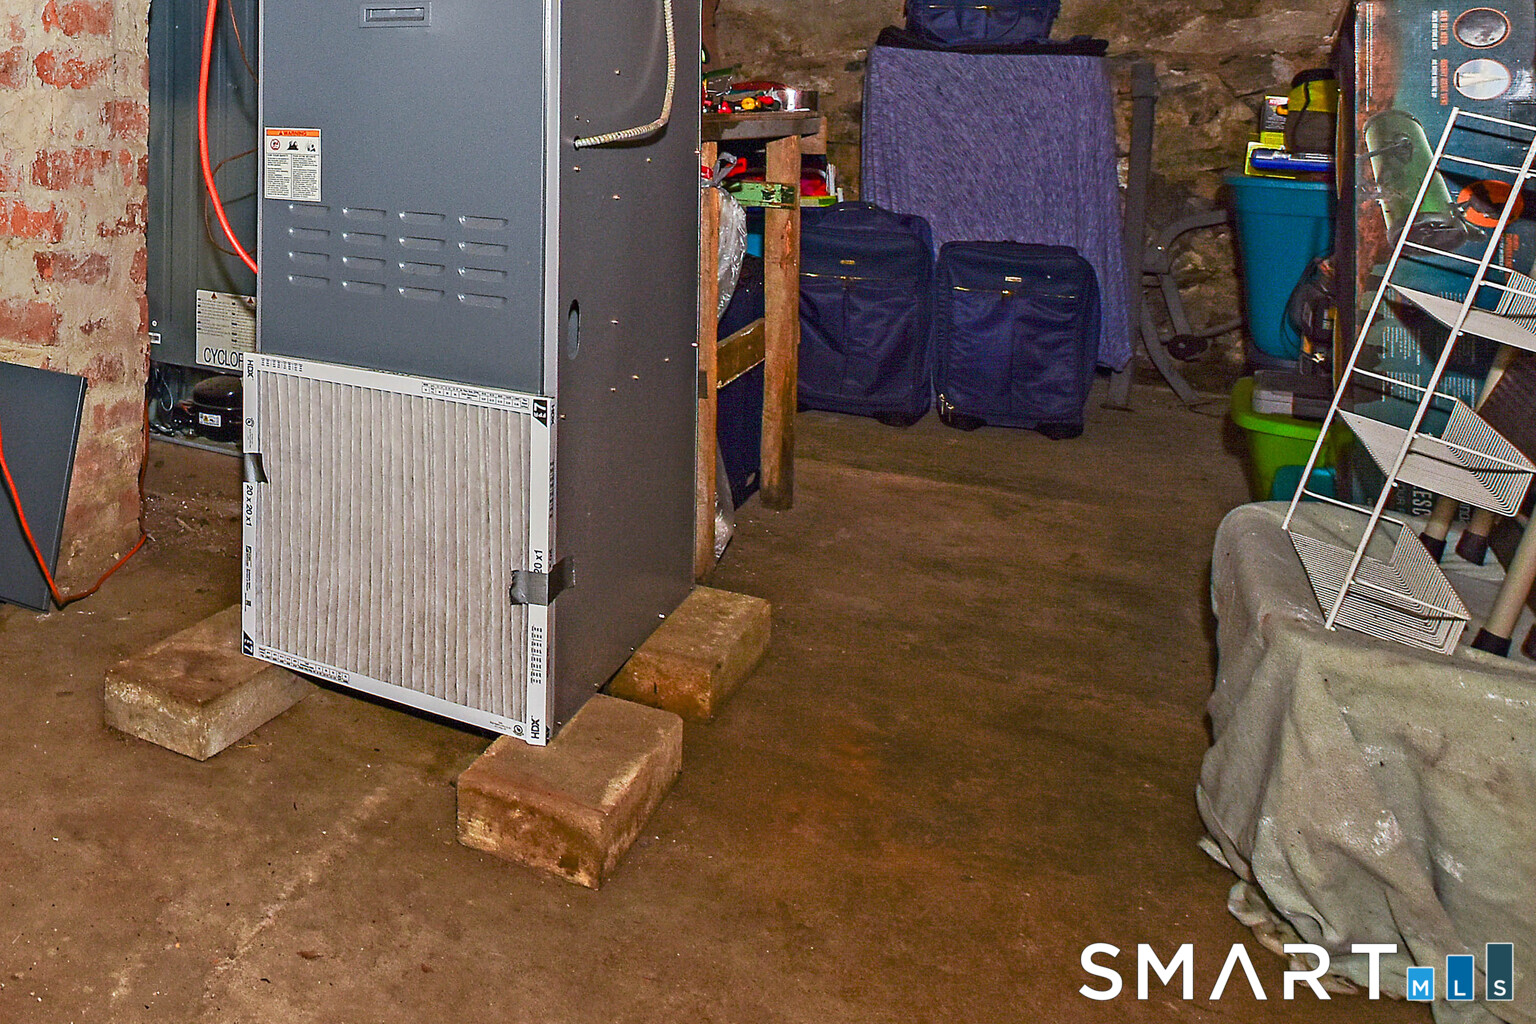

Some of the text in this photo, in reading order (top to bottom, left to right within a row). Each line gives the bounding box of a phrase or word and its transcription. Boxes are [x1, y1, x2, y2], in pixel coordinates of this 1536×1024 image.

[246, 485, 253, 496] 20
[246, 504, 253, 516] 20
[531, 718, 540, 740] HDX
